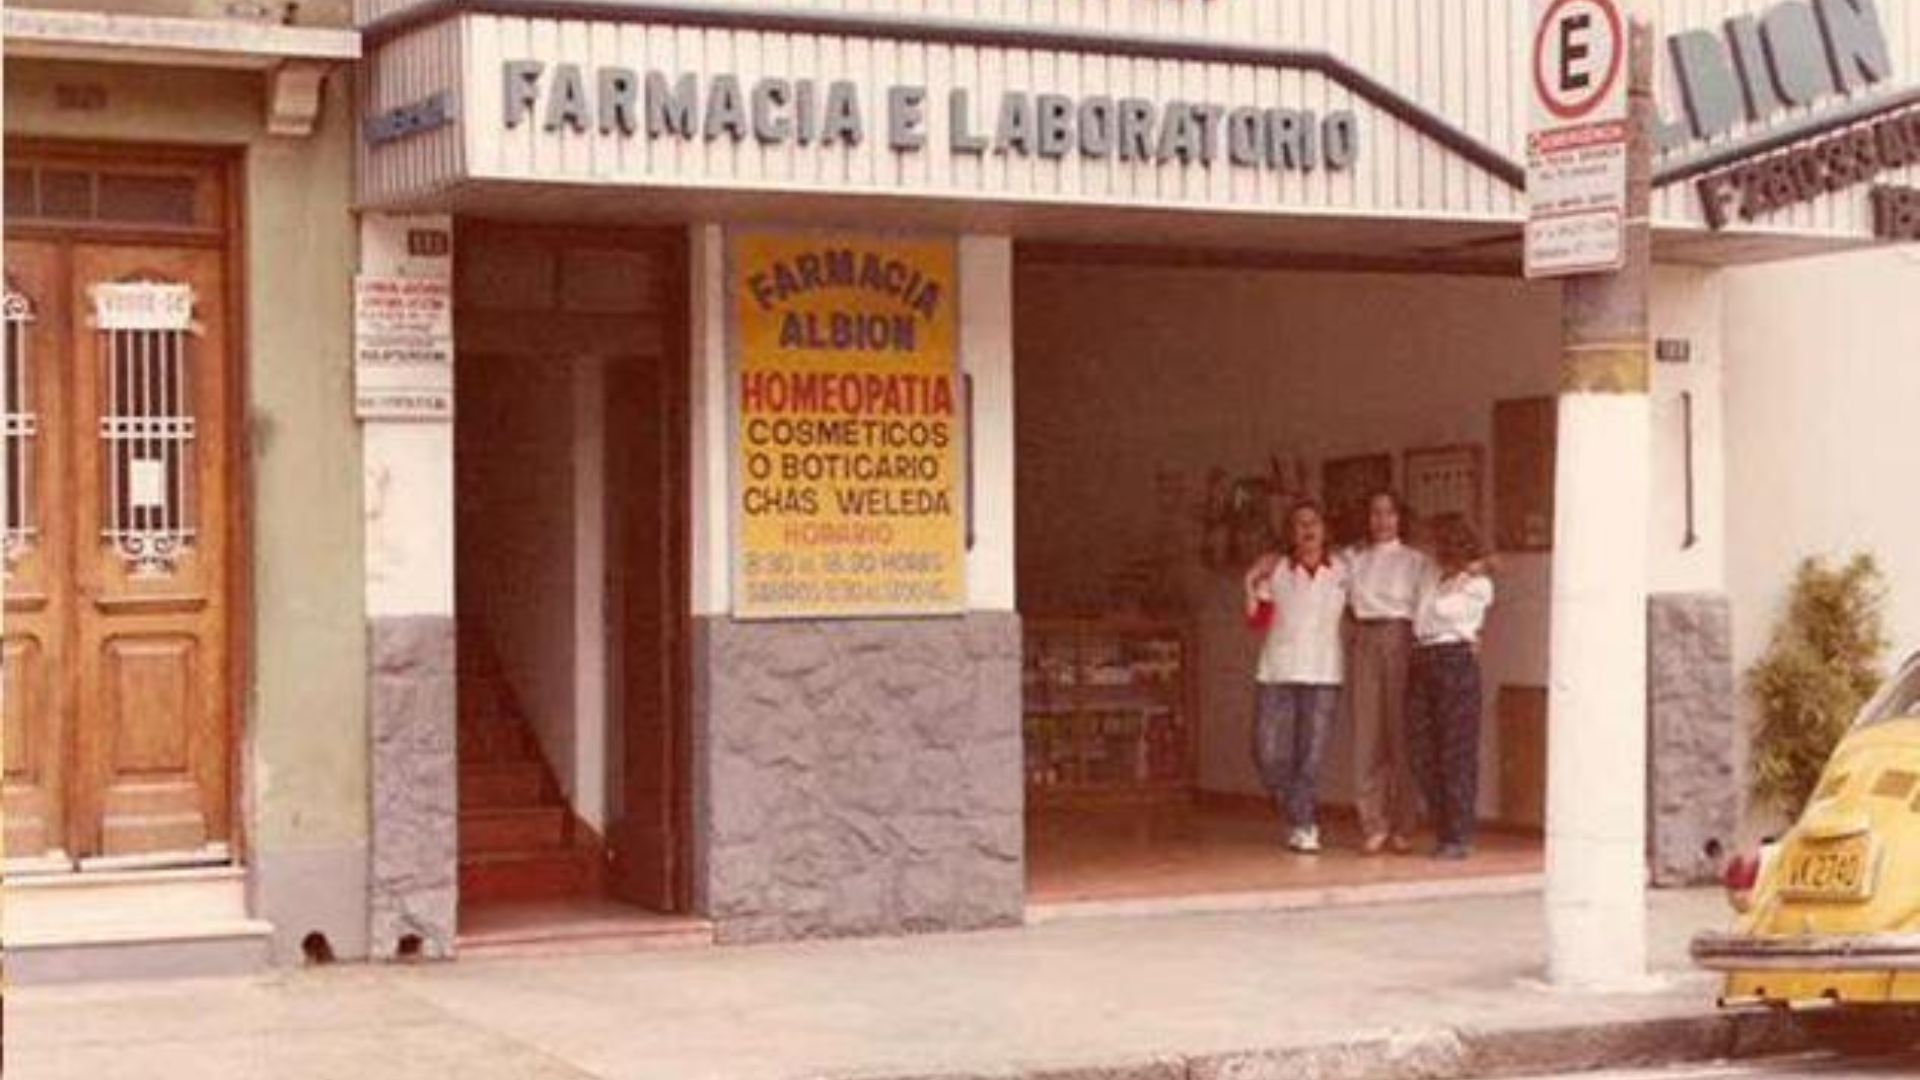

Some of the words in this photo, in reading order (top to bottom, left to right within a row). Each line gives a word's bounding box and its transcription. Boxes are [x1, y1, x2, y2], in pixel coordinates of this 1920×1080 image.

[1560, 14, 1592, 92] E
[501, 60, 863, 148] FARMACIA
[887, 85, 928, 153] E
[948, 88, 1358, 174] LABORATORIO
[747, 249, 941, 321] FARMACIA
[779, 311, 916, 352] ALBION
[741, 370, 955, 415] HOMEOPATIA
[747, 418, 950, 449] COSMETICOS
[748, 452, 771, 480] O
[781, 453, 939, 481] BOTICARIO
[743, 486, 819, 516] CHAS
[834, 488, 952, 517] WELEDA
[783, 522, 893, 546] HORARIO
